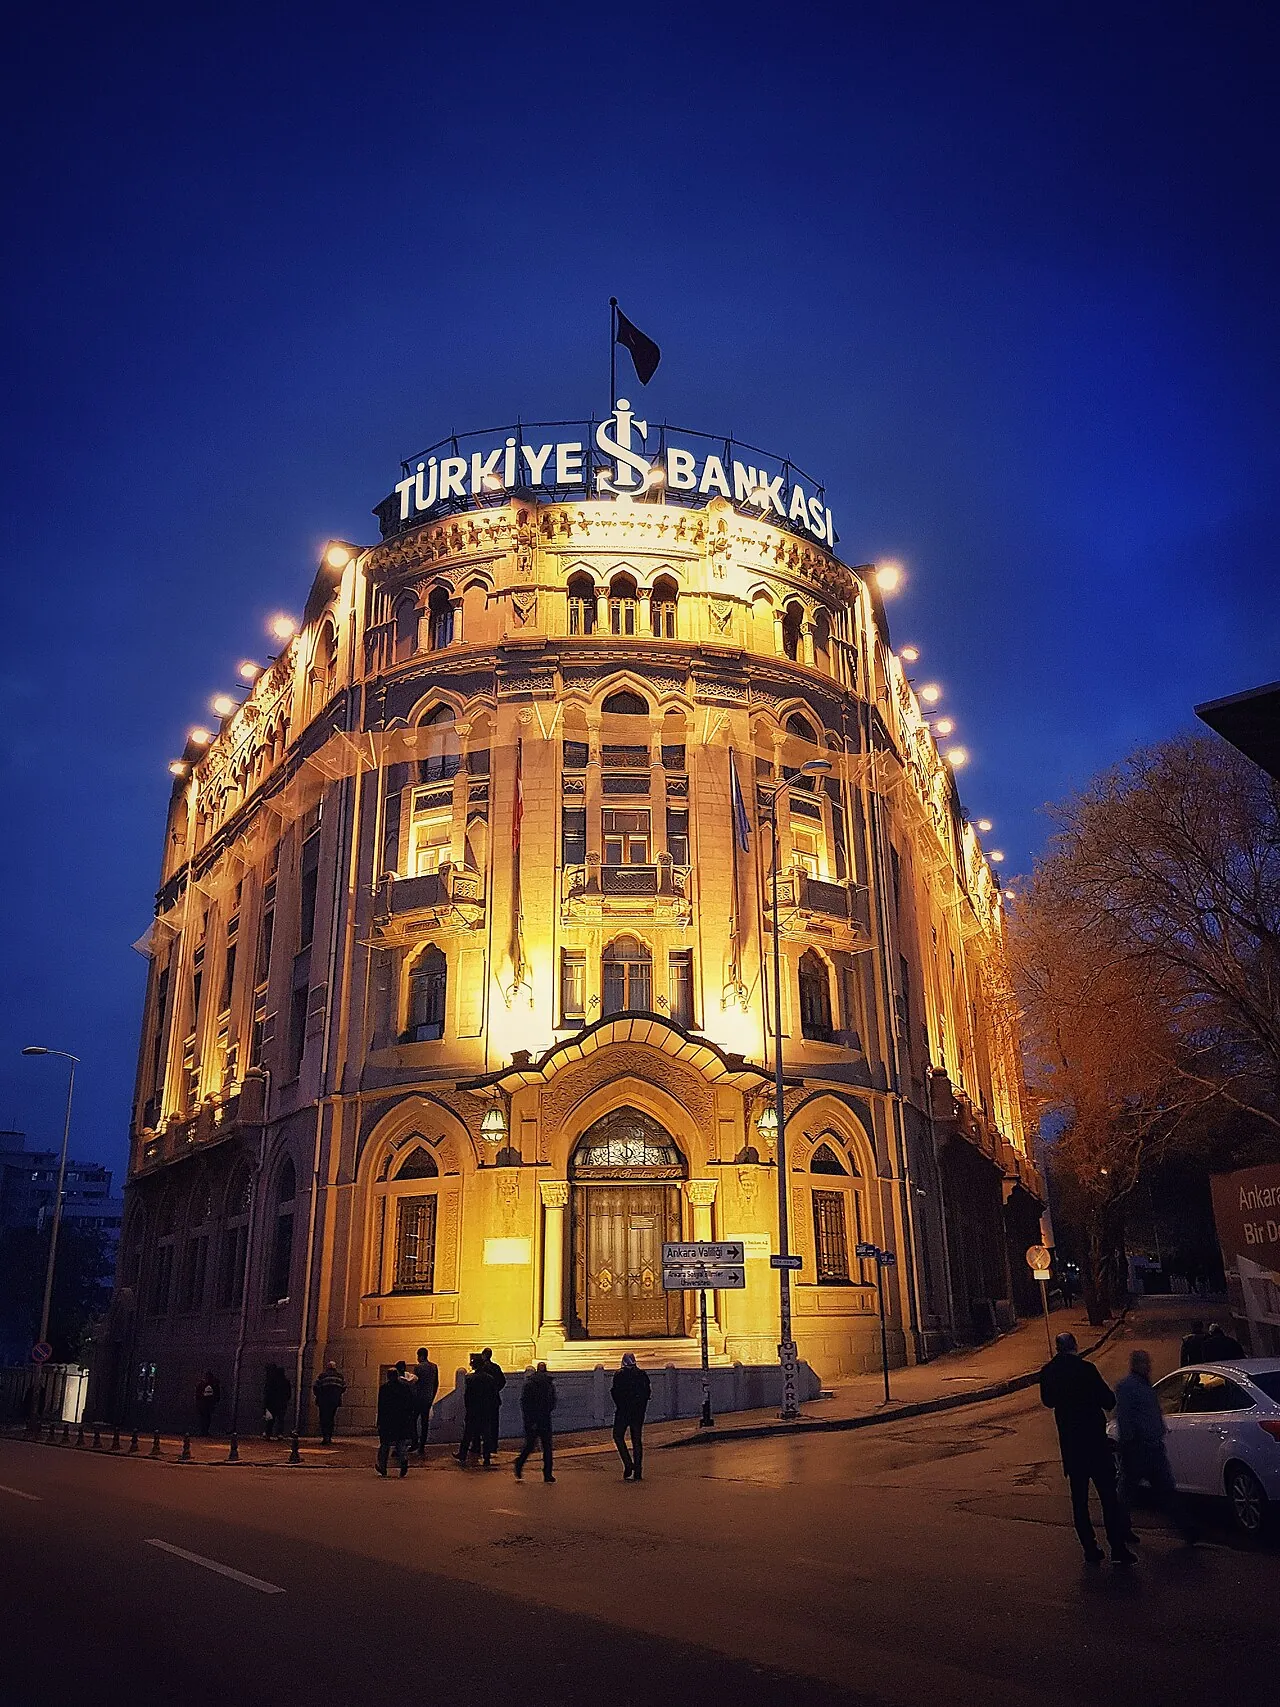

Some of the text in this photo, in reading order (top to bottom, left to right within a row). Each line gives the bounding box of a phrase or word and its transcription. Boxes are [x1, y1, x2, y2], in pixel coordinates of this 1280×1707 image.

[395, 437, 582, 520] TÜRKİYE
[667, 448, 834, 547] BANKASI
[667, 1247, 696, 1258] Ankara
[1243, 1220, 1280, 1245] Bir D
[784, 1343, 796, 1410] OTOPARK
